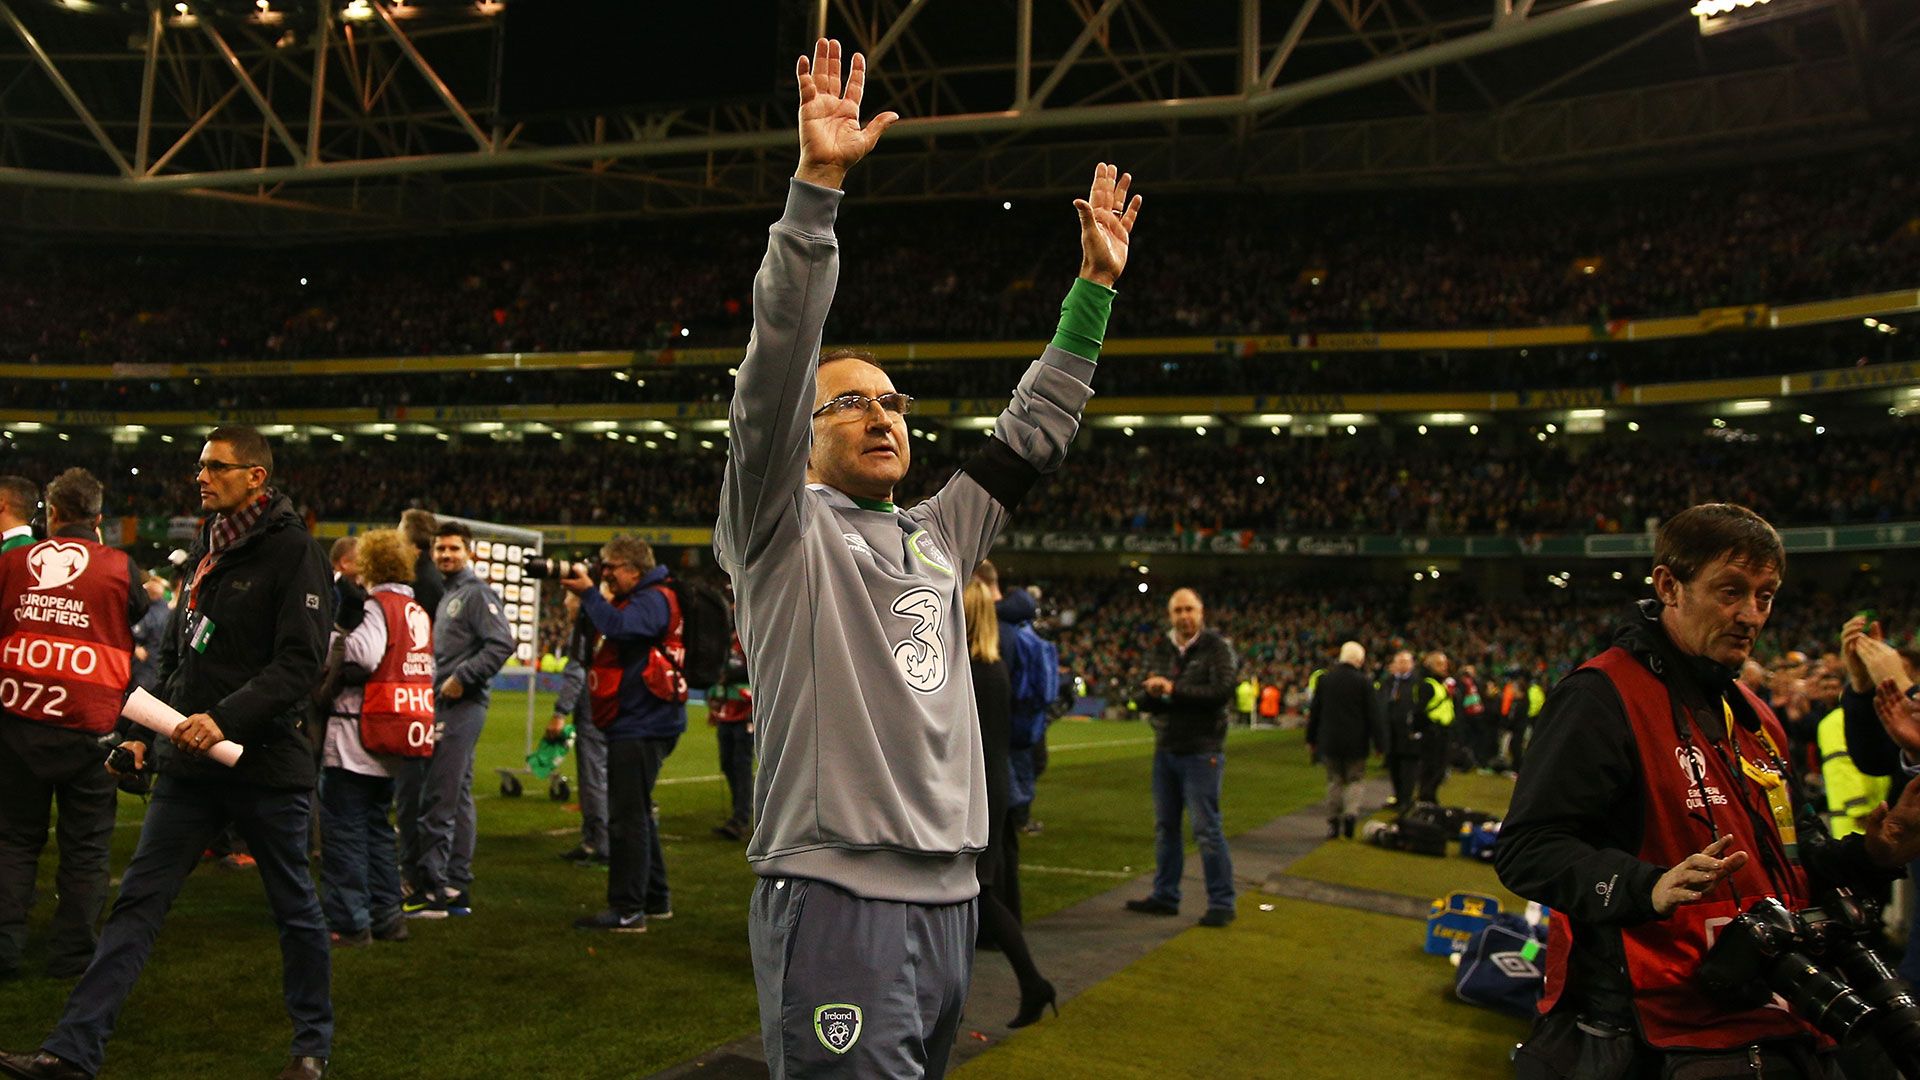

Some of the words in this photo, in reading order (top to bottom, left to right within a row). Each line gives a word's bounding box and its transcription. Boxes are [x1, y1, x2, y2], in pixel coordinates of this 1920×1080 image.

[1277, 394, 1345, 412] AVIVA
[14, 605, 90, 628] QALIFIERS
[890, 586, 948, 695] 3
[0, 677, 67, 717] 072
[824, 1011, 853, 1020] Ireland
